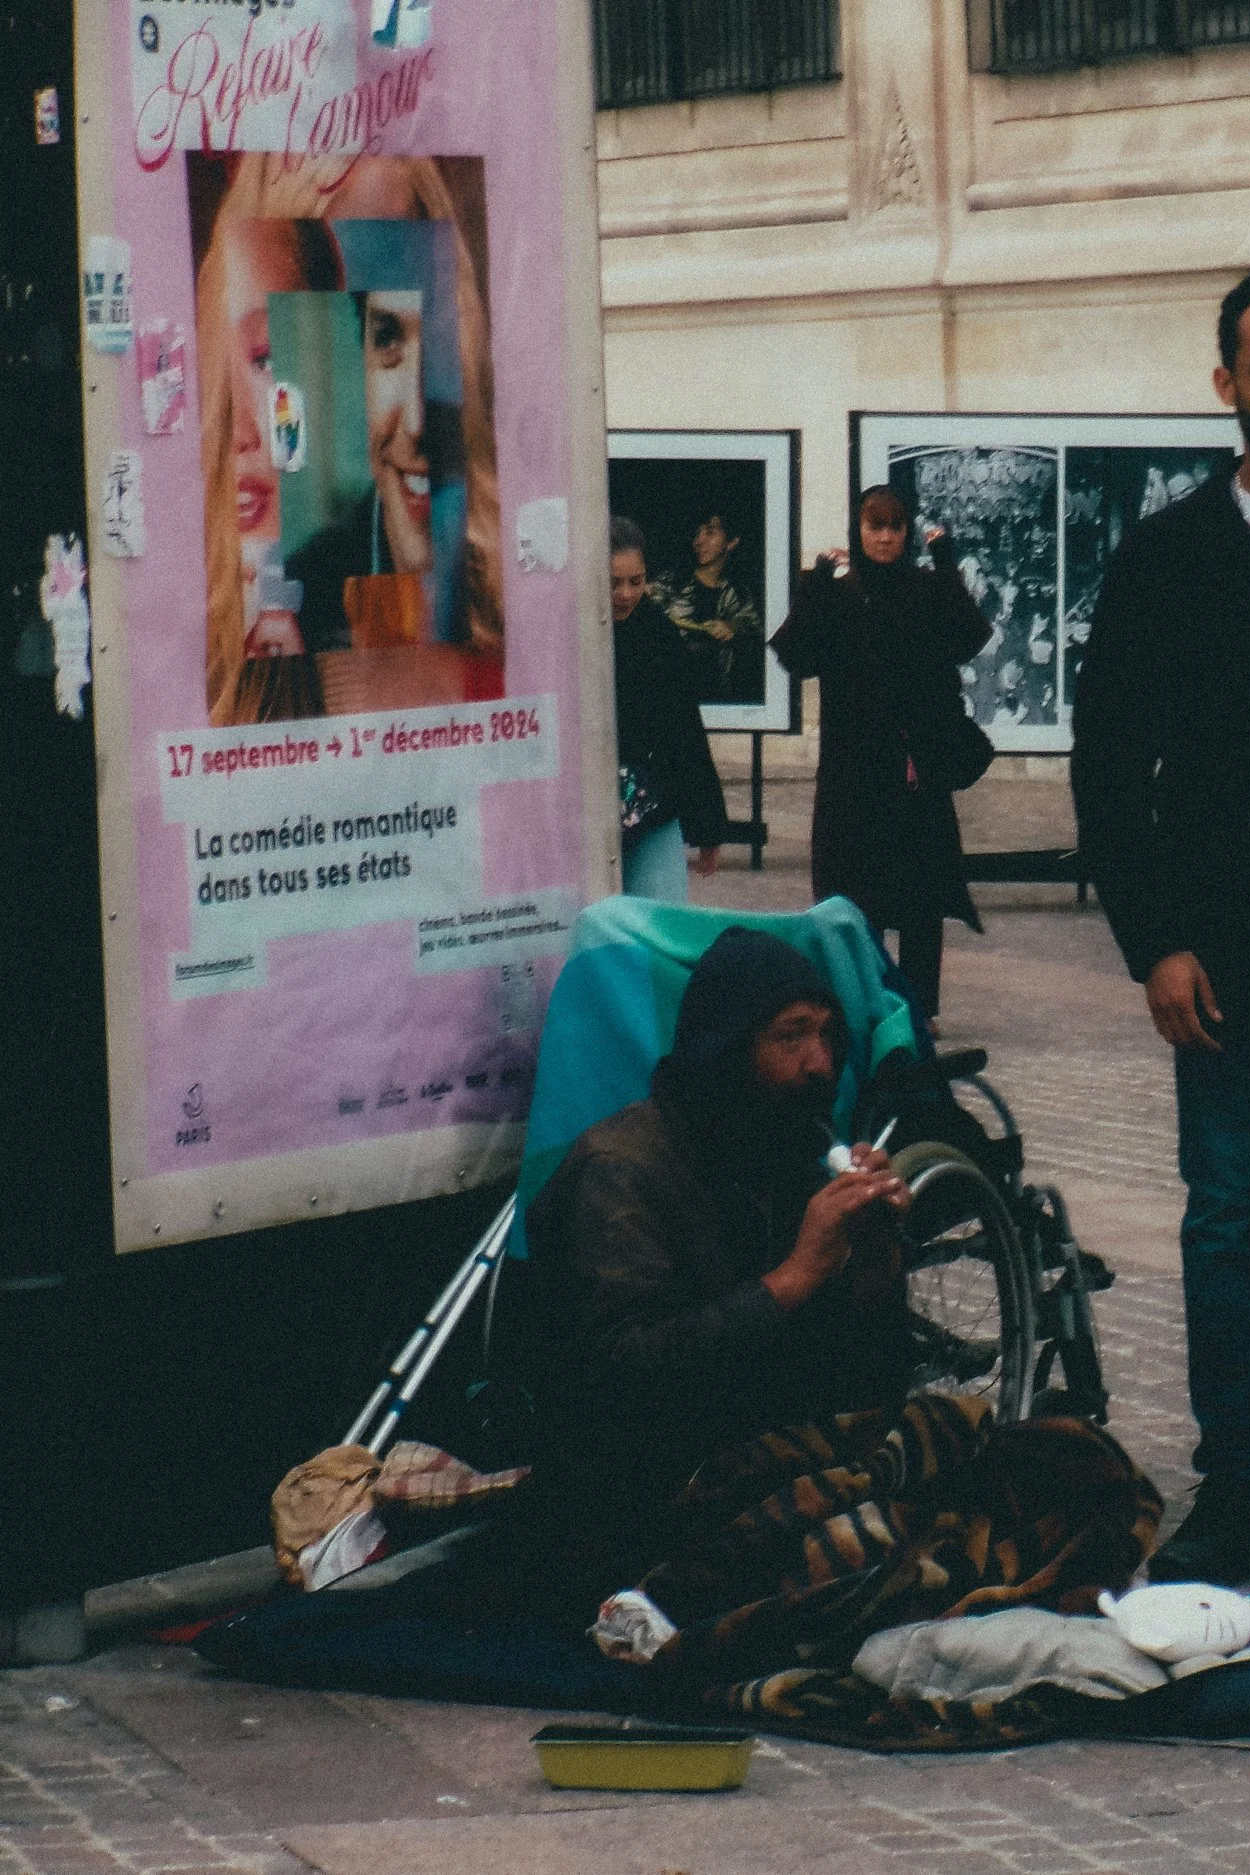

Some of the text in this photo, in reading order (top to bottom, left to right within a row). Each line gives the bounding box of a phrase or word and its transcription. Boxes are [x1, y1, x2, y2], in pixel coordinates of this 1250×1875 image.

[134, 15, 326, 173] Refaire
[167, 707, 540, 780] 17 septembre 1er décembre 2024
[195, 800, 457, 860] La comédie romantique
[198, 850, 412, 906] dans tous ses états
[175, 1124, 212, 1147] PARIS
